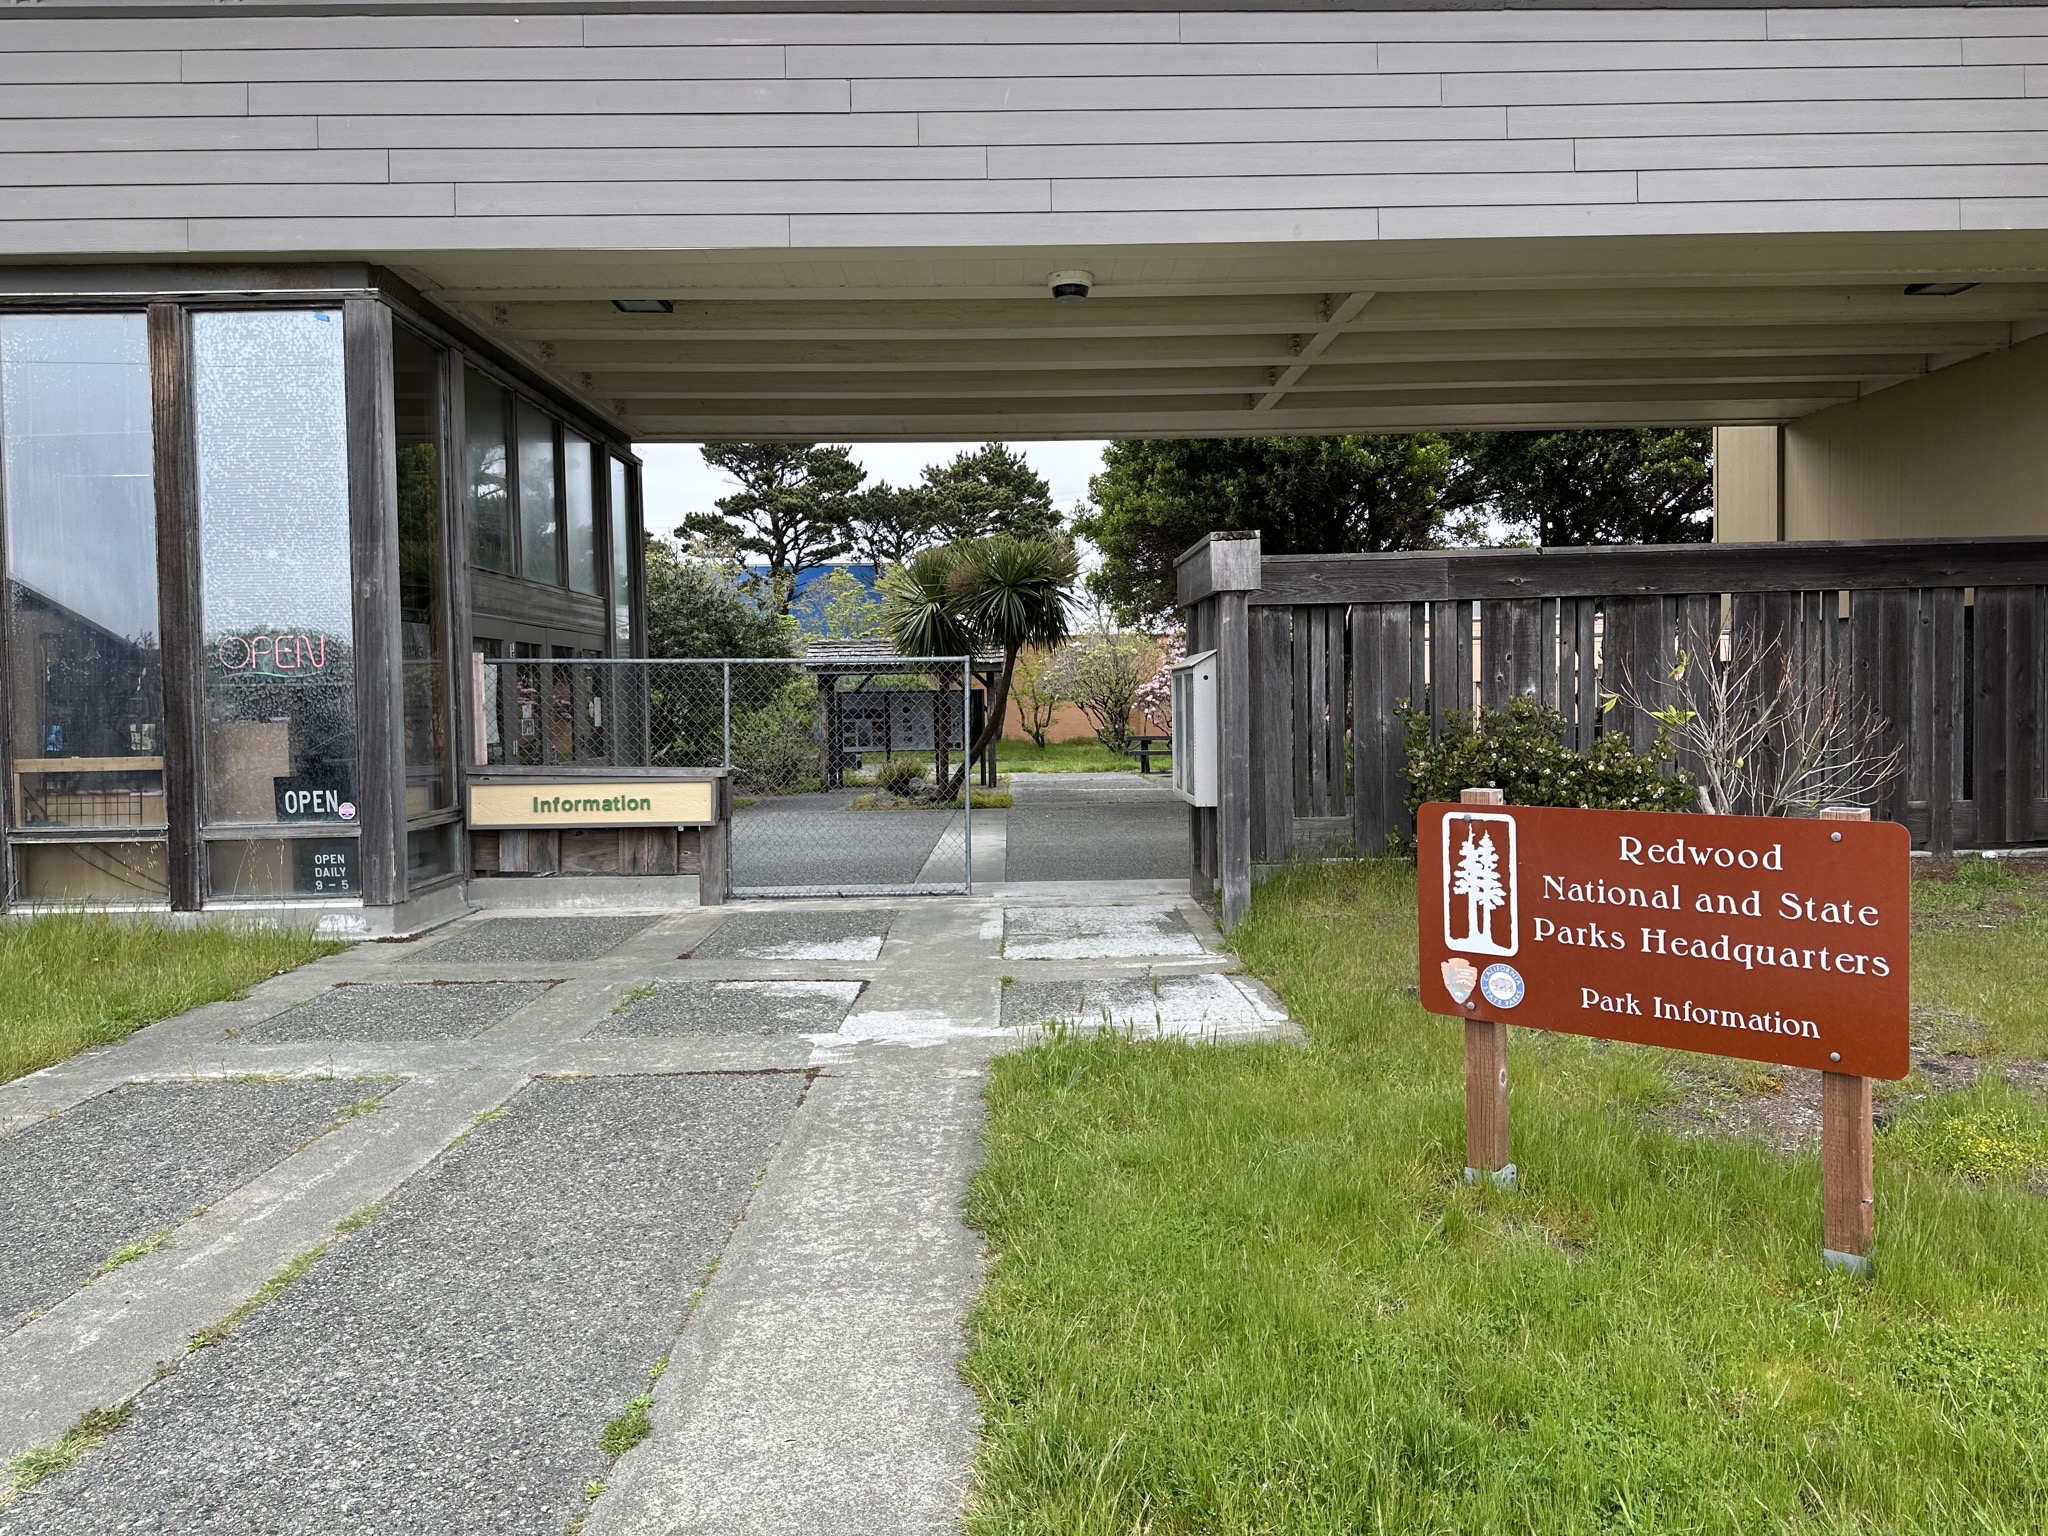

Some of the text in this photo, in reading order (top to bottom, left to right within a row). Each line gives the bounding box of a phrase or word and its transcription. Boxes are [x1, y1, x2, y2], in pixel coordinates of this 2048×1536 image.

[219, 635, 325, 669] OPEN
[284, 789, 339, 814] OPEN
[533, 795, 651, 814] Information
[314, 853, 345, 865] OPEN
[1618, 835, 1784, 871] Redwood
[314, 867, 347, 878] DAILY
[315, 880, 323, 890] 9
[341, 880, 349, 890] 5
[1542, 874, 1880, 927] National and State
[1533, 917, 1891, 977] Parks Headquarters
[1483, 965, 1520, 986] CALIFORNIA
[1483, 985, 1522, 1007] STATE PARKS
[1580, 987, 1821, 1039] Park Information
